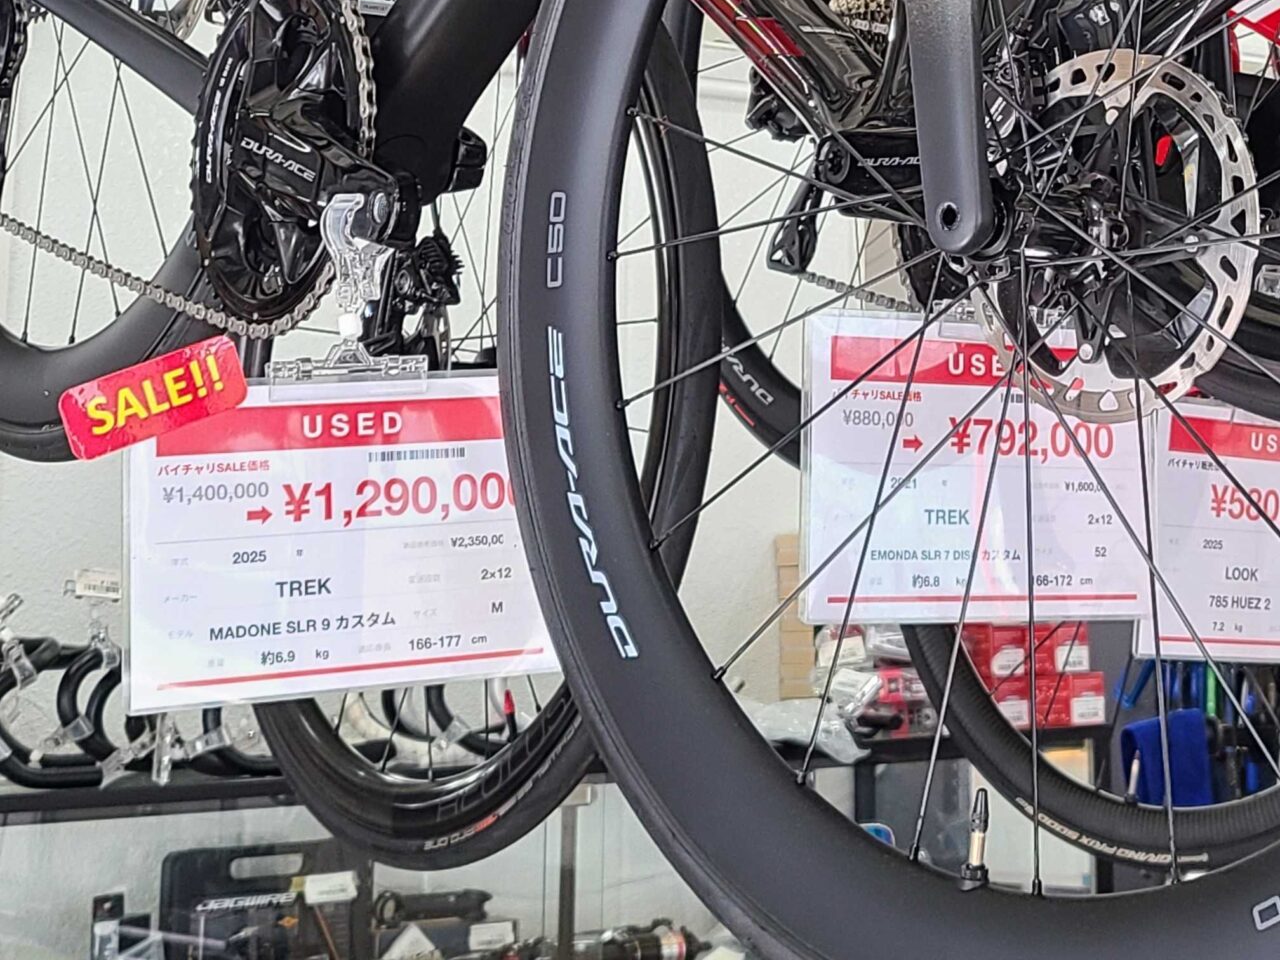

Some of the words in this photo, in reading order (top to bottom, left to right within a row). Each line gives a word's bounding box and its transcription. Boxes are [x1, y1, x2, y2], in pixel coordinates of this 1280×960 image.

[240, 136, 317, 183] DURA-ACE
[857, 155, 921, 167] DURA-AC
[546, 191, 567, 289] C50
[948, 352, 1007, 378] USE
[86, 354, 225, 436] SALE!!
[302, 411, 403, 439] USED
[843, 408, 914, 429] ¥880,00
[948, 416, 1114, 465] ¥792,000
[157, 460, 271, 477] バイチャリSALE価格
[162, 481, 270, 505] ¥1,400,000
[282, 472, 515, 527] ¥1,290,00
[547, 325, 640, 660] DURA-ACE
[924, 508, 970, 526] TREK
[1094, 546, 1107, 558] 52
[1203, 539, 1223, 550] 2025
[232, 550, 267, 565] 2025
[870, 549, 919, 562] EMONDA
[920, 549, 944, 562] SLR
[944, 550, 950, 561] 7
[952, 550, 974, 561] DIS
[912, 574, 940, 589] 約6.8
[1079, 577, 1093, 586] cm
[1225, 566, 1259, 582] LOOK
[275, 577, 332, 599] TREK
[491, 601, 504, 614] M
[1209, 594, 1229, 609] 785
[1231, 596, 1262, 610] HUEZ
[1263, 597, 1271, 610] 2
[209, 621, 282, 642] MADONE
[286, 618, 318, 634] SLR
[321, 617, 331, 631] 9
[335, 611, 396, 631] カスタム
[1212, 621, 1225, 632] 7.2
[1234, 623, 1243, 633] kg
[408, 635, 462, 651] 166-177
[471, 634, 488, 645] cm
[260, 650, 296, 666] 約6.9
[315, 649, 330, 660] kg
